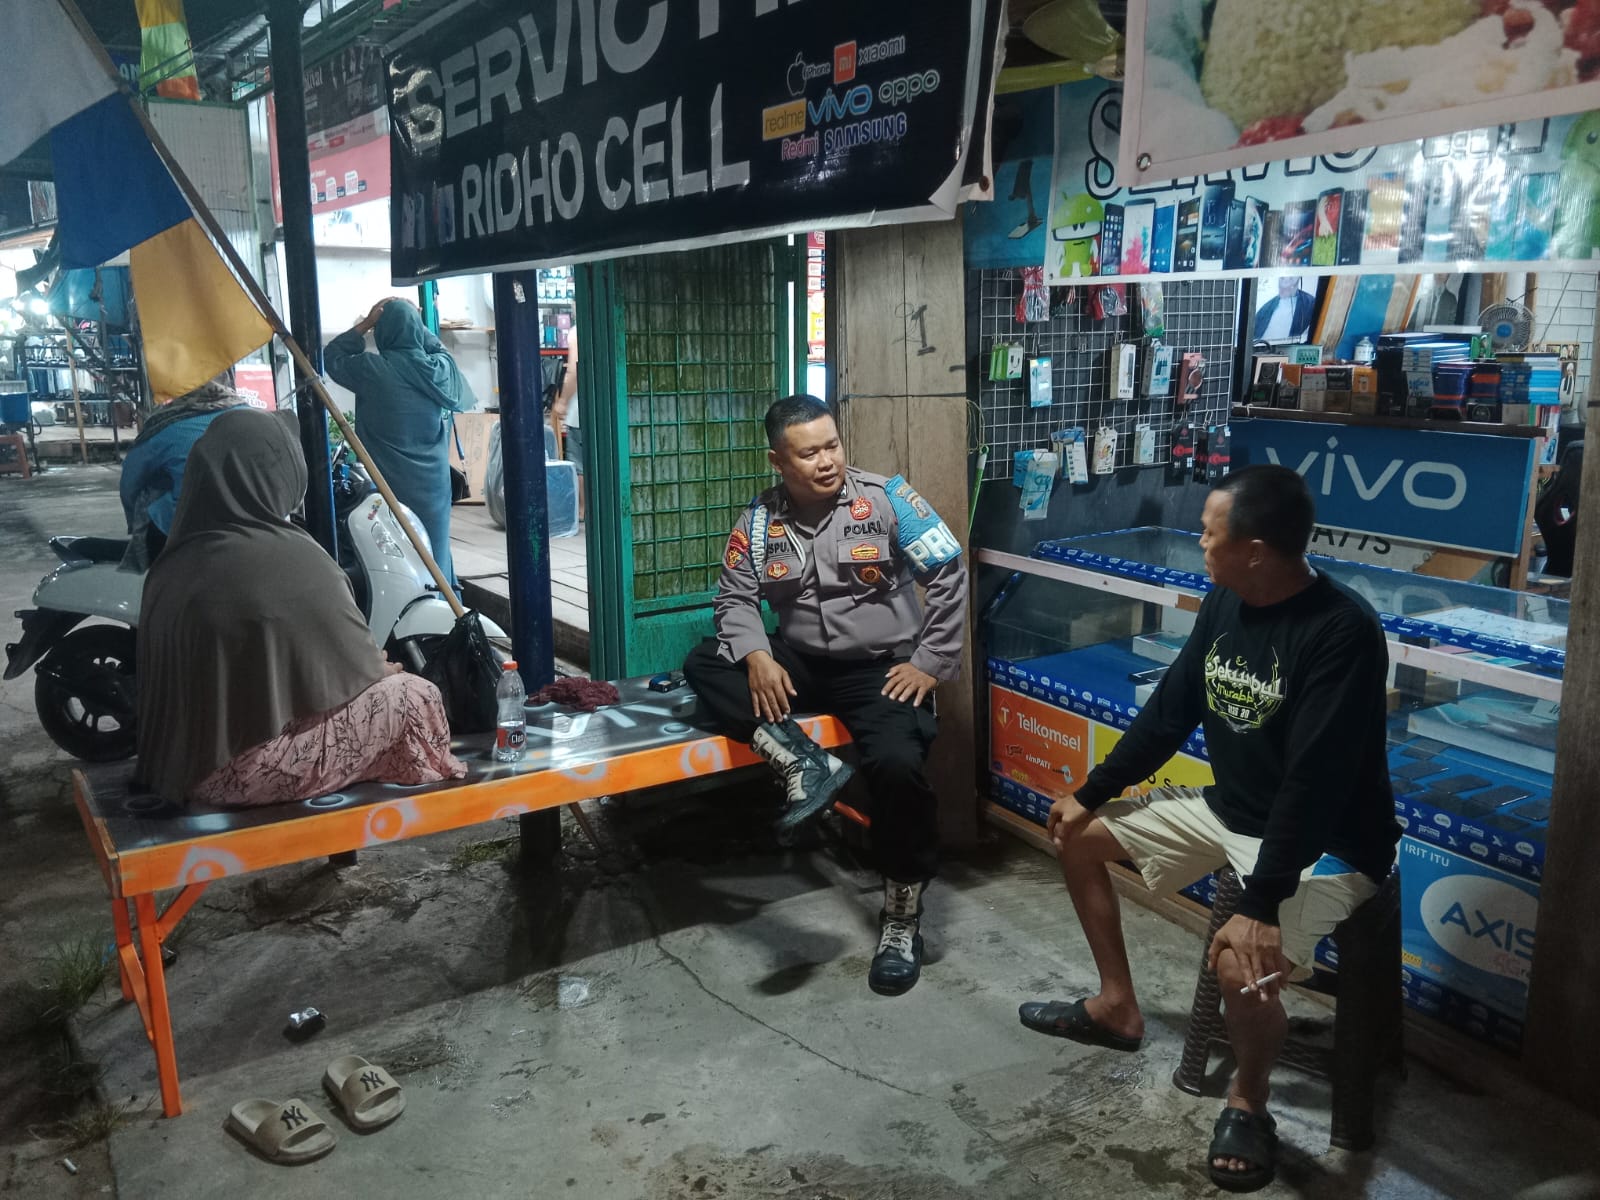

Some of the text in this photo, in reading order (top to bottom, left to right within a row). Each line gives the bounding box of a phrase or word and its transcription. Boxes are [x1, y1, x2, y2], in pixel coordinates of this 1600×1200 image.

[858, 35, 906, 66] xiaomi
[879, 69, 940, 106] oppo
[764, 109, 805, 134] realme
[781, 112, 907, 161] Redmi SAMSUNG
[461, 131, 585, 239] RIDHO
[595, 83, 750, 210] CELL
[1016, 711, 1081, 753] Telkomsel
[1404, 842, 1449, 867] IRIT ITU
[1439, 901, 1537, 960] AXIS
